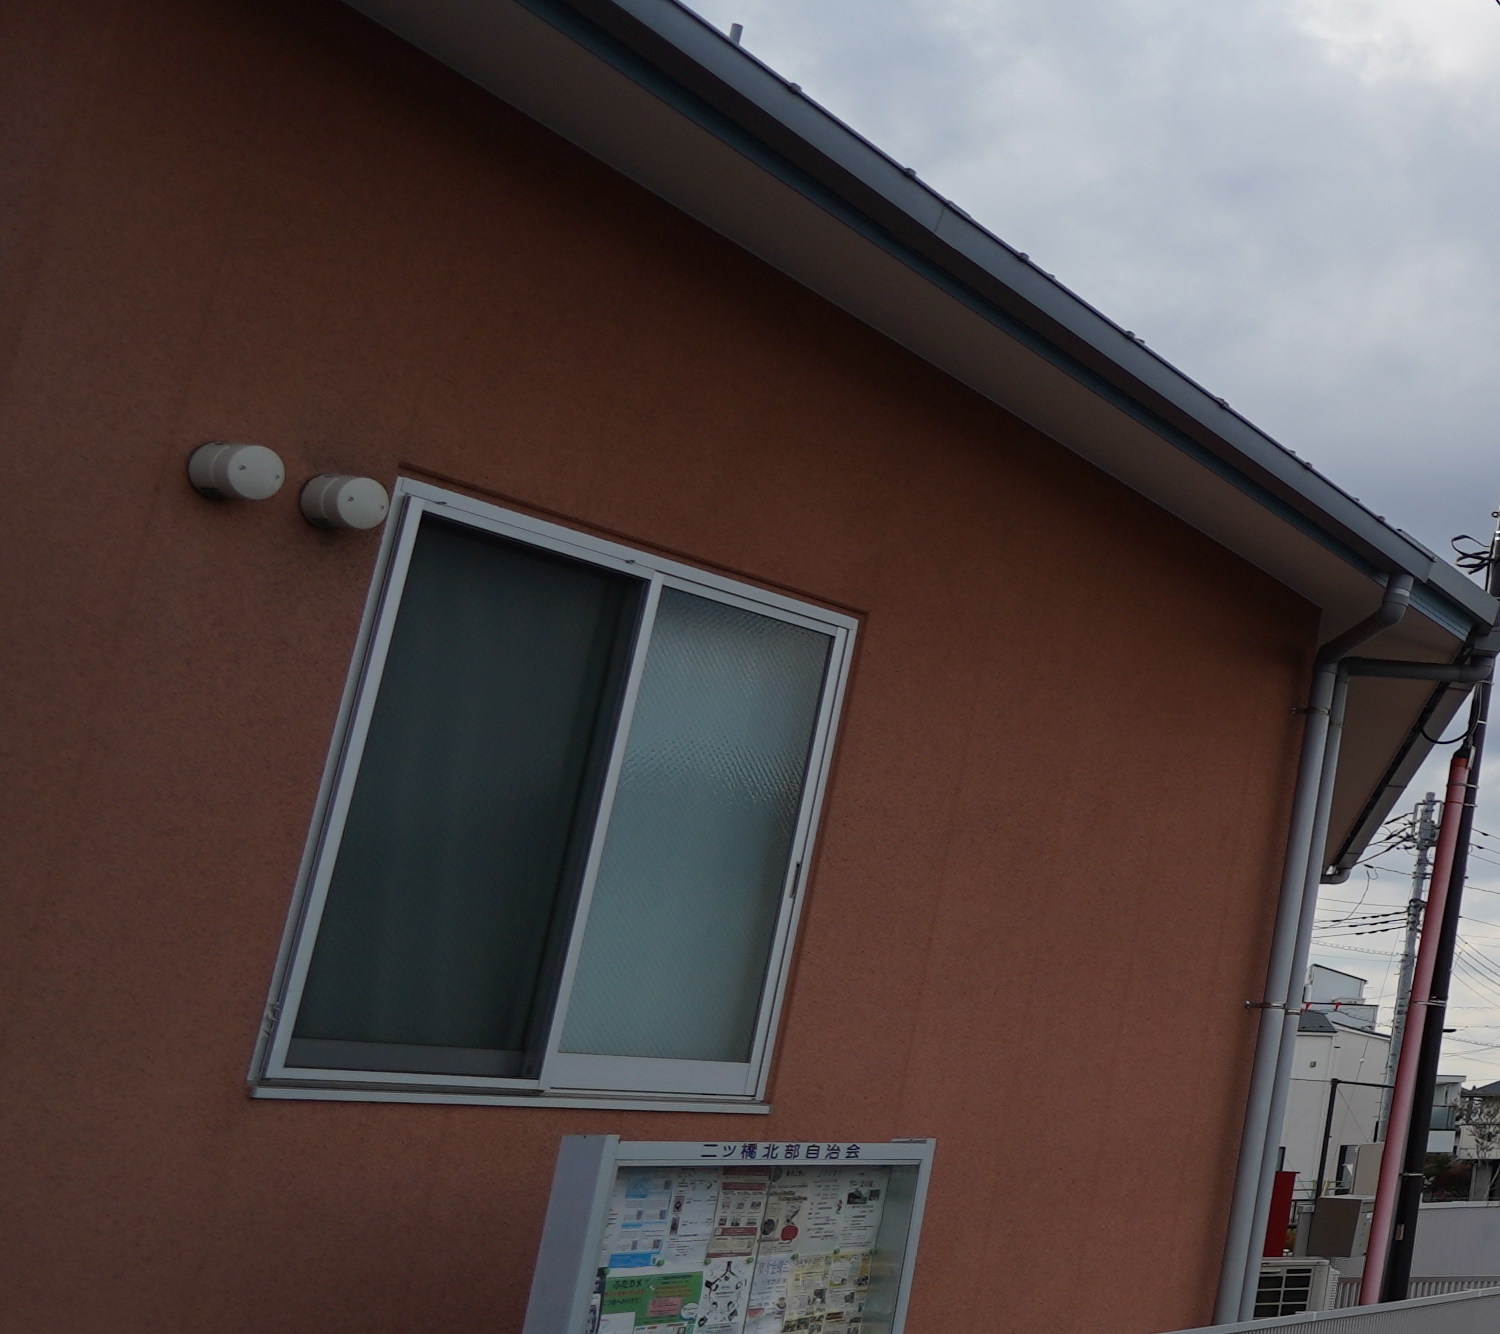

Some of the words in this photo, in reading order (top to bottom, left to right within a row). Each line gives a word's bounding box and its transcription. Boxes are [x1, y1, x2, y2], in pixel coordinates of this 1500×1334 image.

[700, 1142, 861, 1160] 二ツ橋北部自治会
